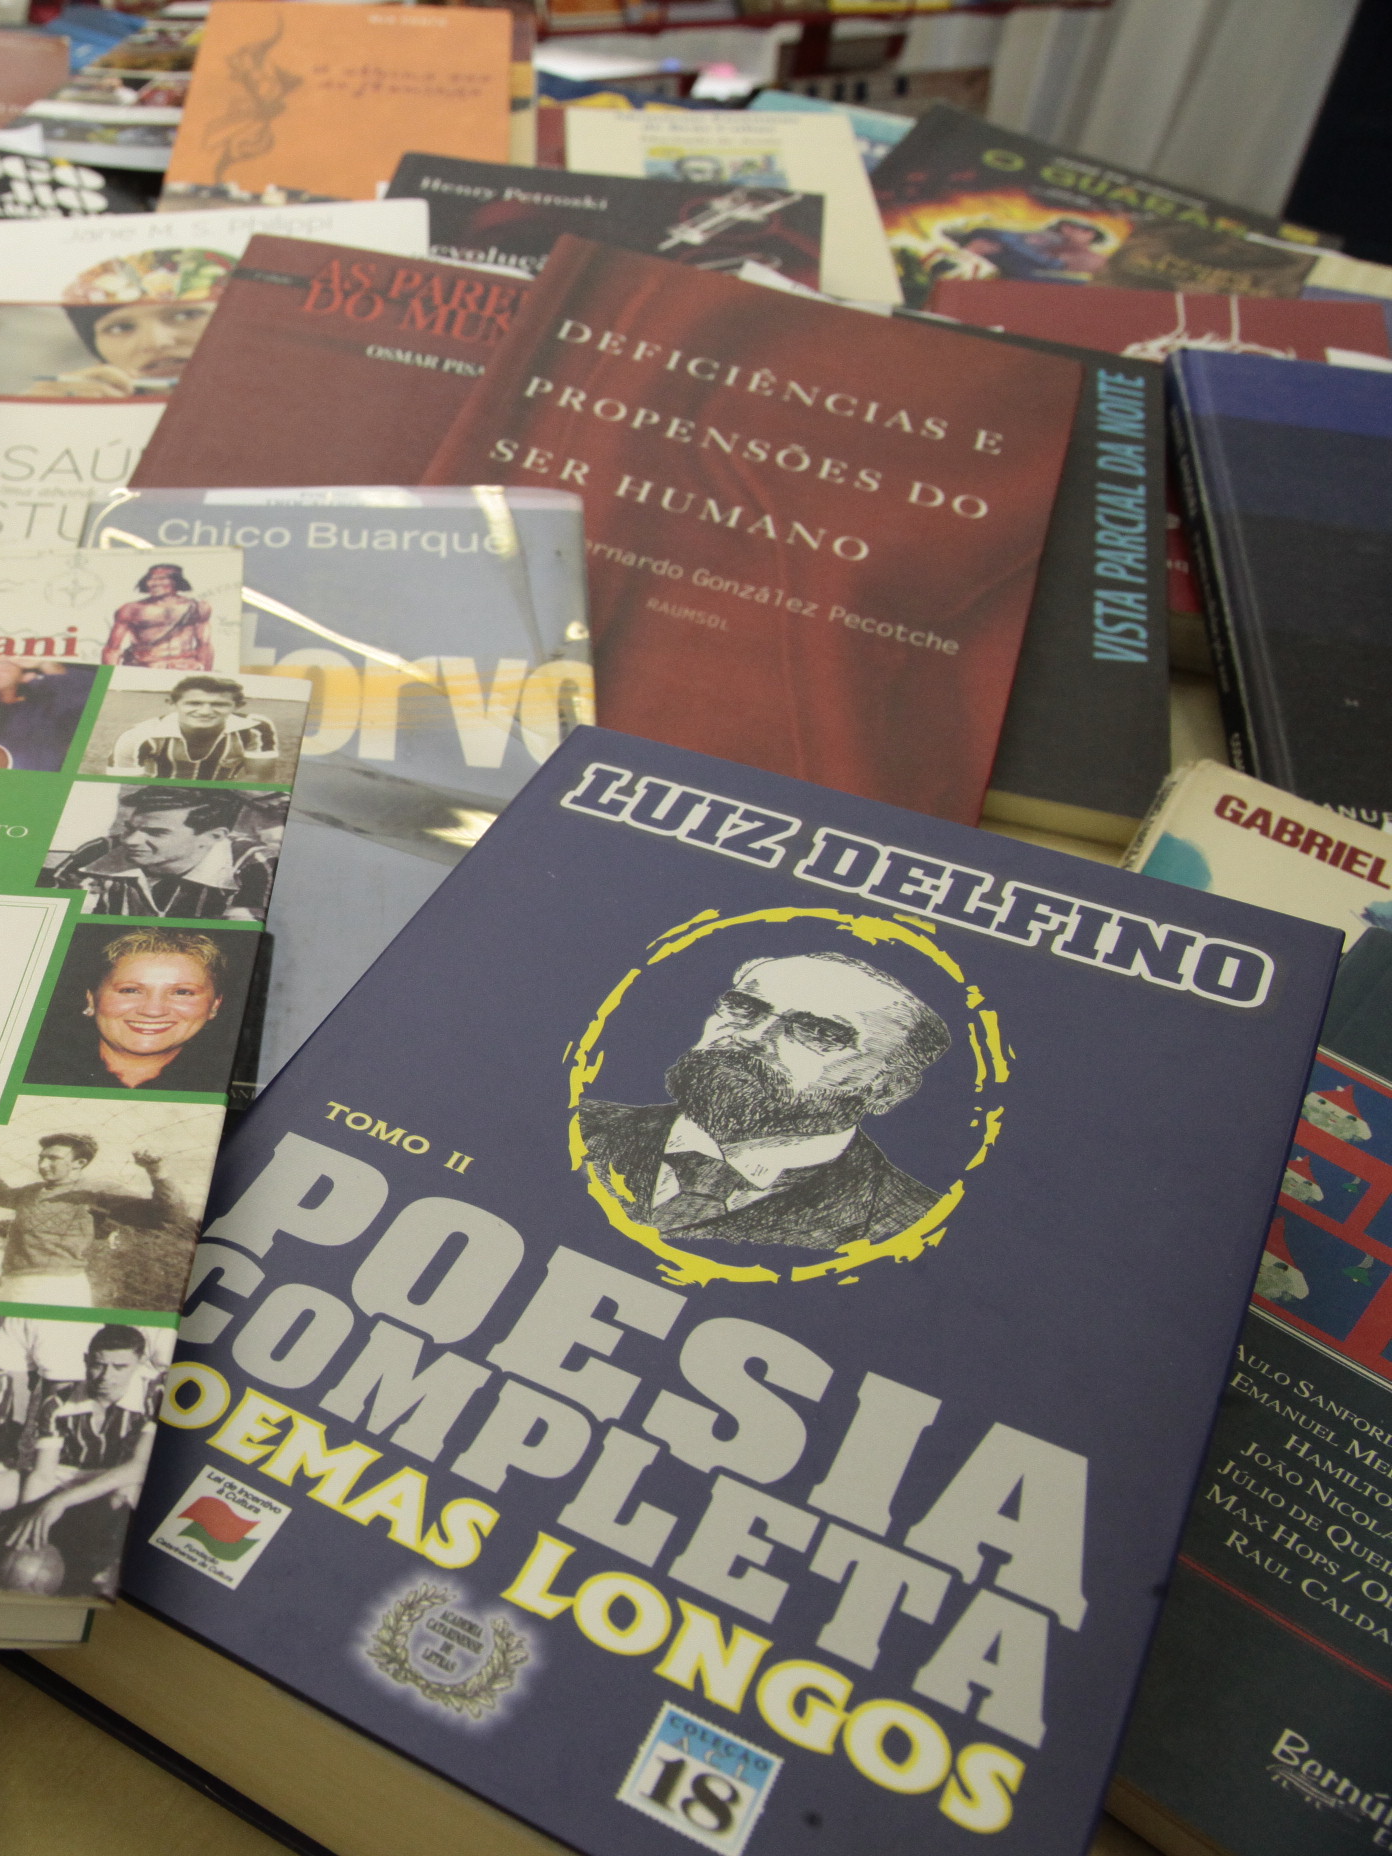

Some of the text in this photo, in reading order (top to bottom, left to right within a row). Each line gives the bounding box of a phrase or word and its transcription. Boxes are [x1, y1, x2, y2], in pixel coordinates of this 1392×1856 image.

[388, 268, 528, 316] PARE
[555, 318, 1003, 456] DEFICIÊNCIAS E
[0, 438, 144, 484] SAÚ
[522, 374, 989, 521] PROPENSÕES DO
[157, 518, 511, 559] Chico Buarque
[488, 437, 871, 563] SER HUMANO
[1092, 368, 1149, 664] VISTA PARCIAL DA NOITE
[691, 567, 821, 619] González
[827, 604, 961, 656] Pecotche
[560, 763, 1277, 1008] LUIZ DELFINO
[1213, 793, 1391, 890] GABRIEL
[325, 1100, 475, 1175] TOMO II
[198, 1132, 1090, 1632] POESIA
[1230, 1371, 1339, 1447] EMANUEL
[178, 1242, 1050, 1749] COMPLETA
[206, 1470, 282, 1515] Lei de Incentivo
[224, 1491, 261, 1514] Cultura
[1240, 1441, 1304, 1486] JOÃO
[1283, 1433, 1392, 1510] HAMILTO
[1205, 1483, 1269, 1533] MAX
[1270, 1523, 1340, 1576] HOPS
[1217, 1459, 1392, 1577] JÚLIO DE QUEI
[1224, 1529, 1392, 1647] RAUL CALDA
[500, 1530, 1026, 1834] LONGOS
[669, 1715, 769, 1772] COLEÇÃO
[638, 1756, 741, 1834] 18
